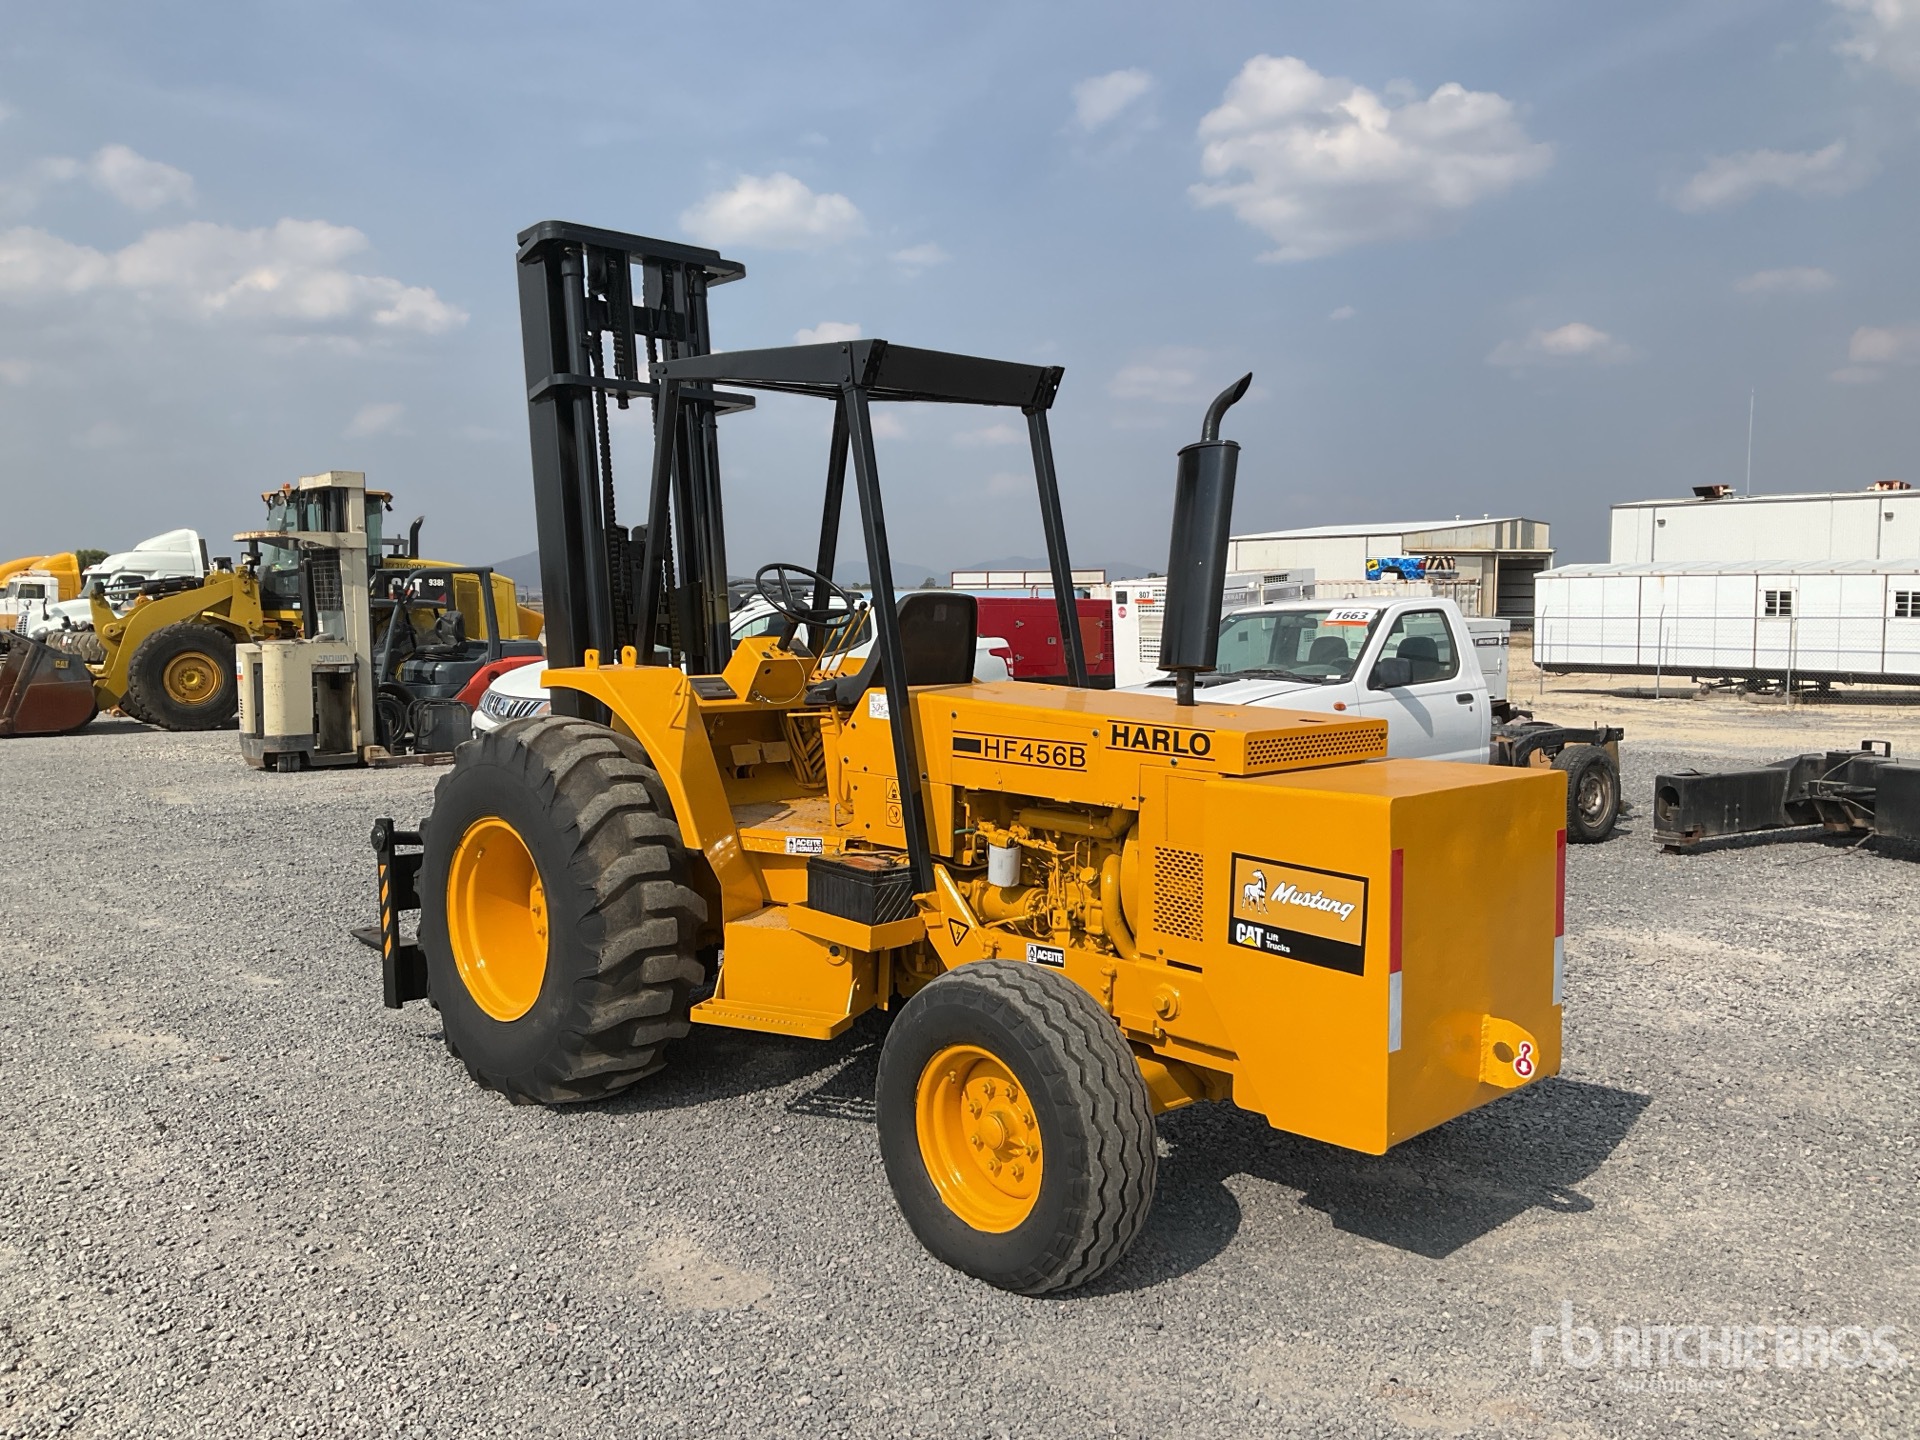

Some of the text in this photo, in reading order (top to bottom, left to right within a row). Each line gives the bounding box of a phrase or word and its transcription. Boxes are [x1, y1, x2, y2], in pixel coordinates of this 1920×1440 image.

[1138, 591, 1150, 599] 807
[1335, 611, 1369, 620] 1663
[55, 660, 69, 668] CAT
[1111, 724, 1212, 756] HARLO
[983, 737, 1086, 768] HF456B
[796, 838, 822, 847] ACEITE
[1270, 881, 1355, 922] Mustang
[1236, 923, 1264, 948] CAT
[1266, 932, 1279, 942] Lift
[1265, 940, 1291, 953] Trucks
[1036, 949, 1064, 964] ACEITE
